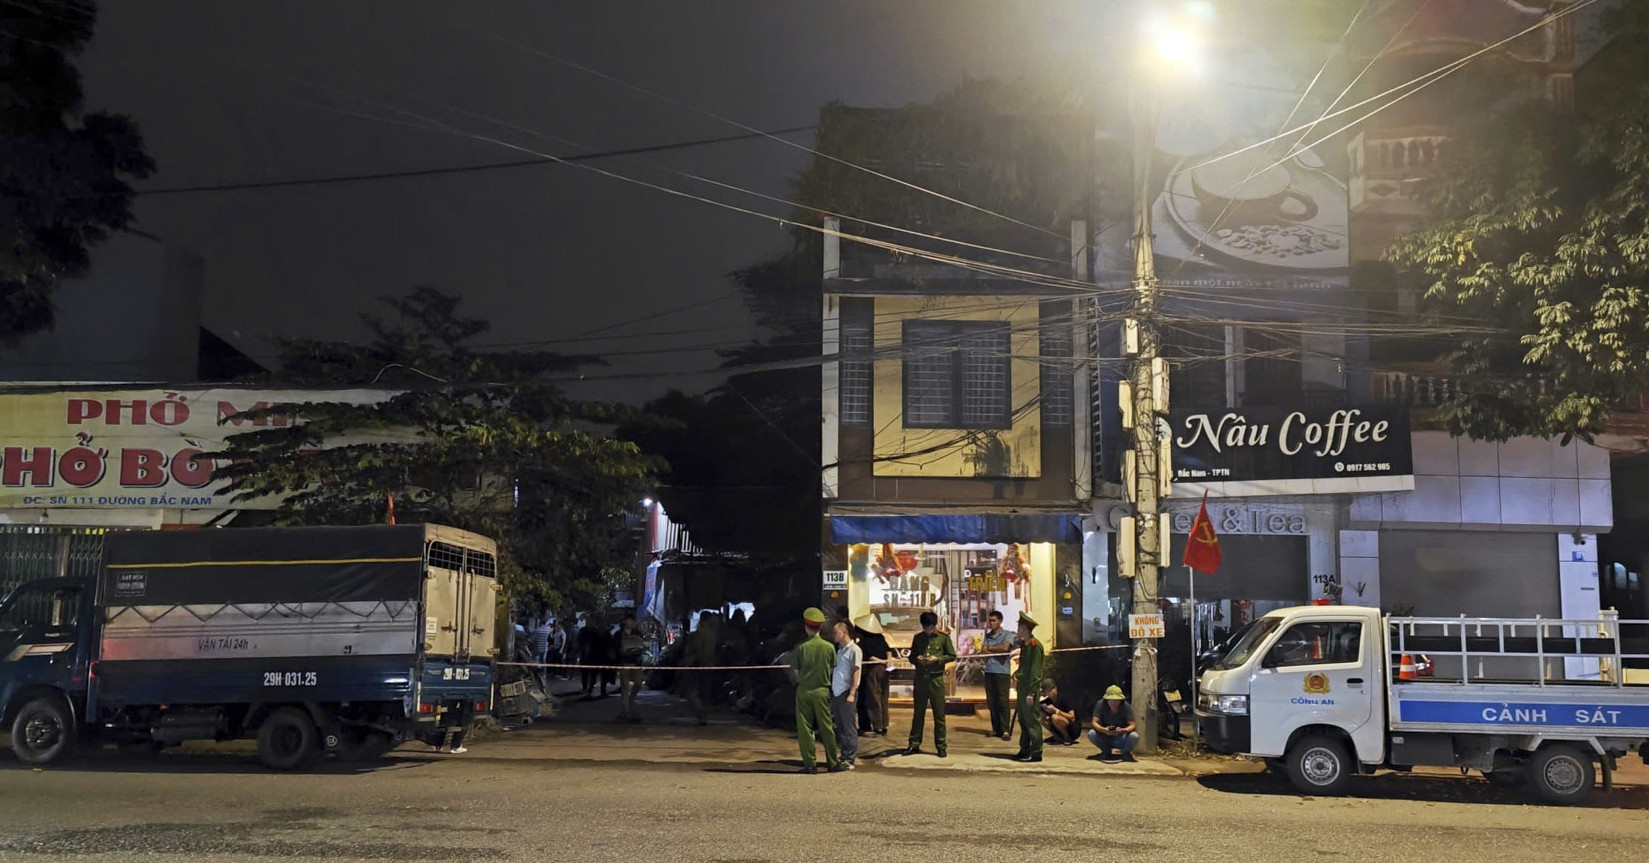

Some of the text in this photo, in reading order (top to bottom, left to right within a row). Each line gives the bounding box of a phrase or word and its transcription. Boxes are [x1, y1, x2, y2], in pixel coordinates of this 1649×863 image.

[1177, 409, 1388, 457] Nâu Coffee
[0, 432, 109, 487] HỞ
[119, 438, 217, 489] BÒ
[1346, 463, 1362, 472] 0917
[1191, 469, 1206, 477] Nam
[50, 497, 67, 505] SN
[72, 497, 94, 505] 111
[150, 492, 178, 505] BẮC
[181, 496, 212, 505] NAM
[826, 572, 845, 582] 113B
[1313, 575, 1336, 583] 113A
[1134, 615, 1160, 625] KHÔNG
[1148, 628, 1163, 637] XE
[233, 638, 248, 650] 24h
[1291, 696, 1335, 706] CÔNG AN
[1481, 702, 1621, 725] CẢNH SÁT
